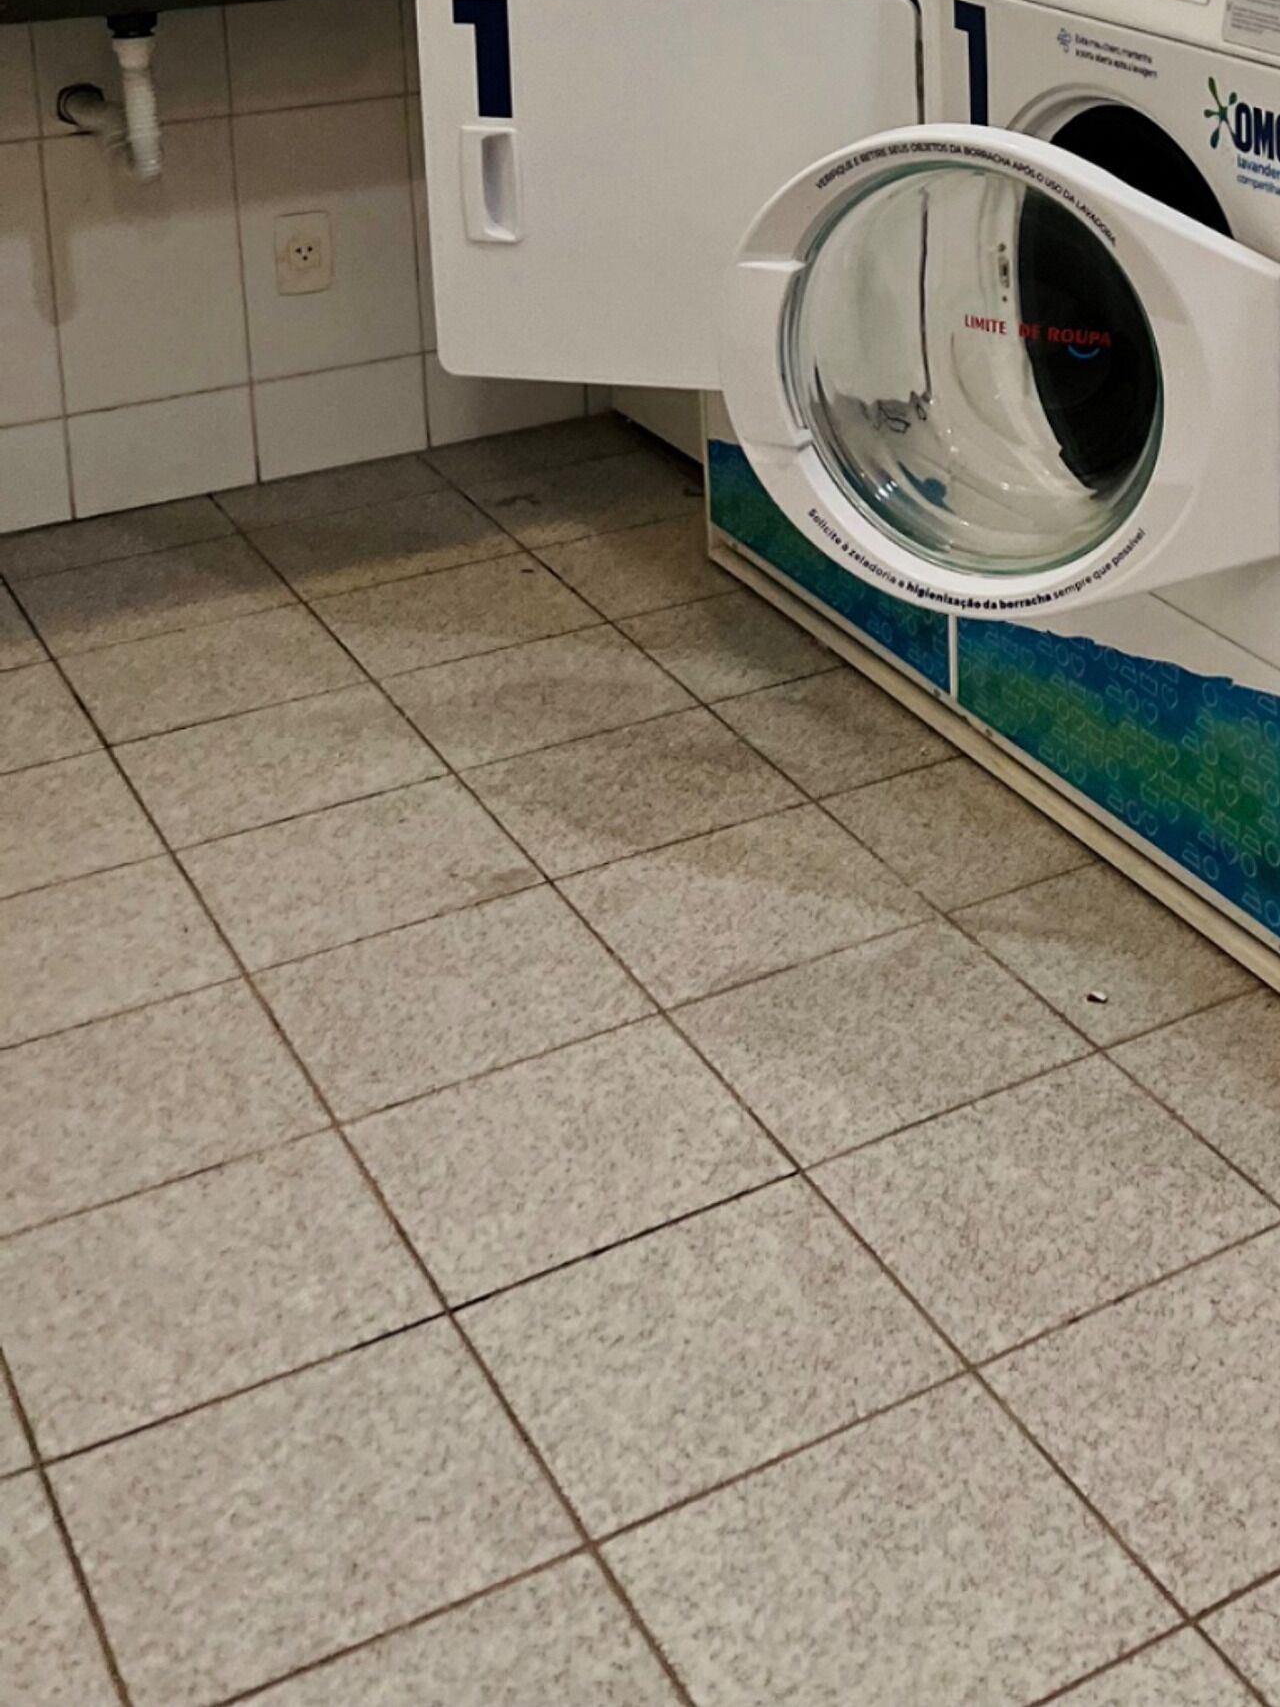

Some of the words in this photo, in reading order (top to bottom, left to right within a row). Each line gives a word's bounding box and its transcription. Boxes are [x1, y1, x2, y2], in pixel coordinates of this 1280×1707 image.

[888, 143, 910, 155] SEUS
[949, 144, 962, 154] DA
[964, 146, 1011, 167] BORRACHA
[1012, 161, 1036, 179] APÓS
[1036, 172, 1045, 183] O
[1044, 178, 1063, 195] USO
[1063, 189, 1076, 203] DA
[965, 314, 1007, 335] LIMITE
[1018, 322, 1040, 339] DE
[1047, 327, 1112, 347] ROUPA
[808, 508, 842, 545] Solicite
[848, 548, 897, 585] zeladoria
[906, 583, 981, 611] higienização
[983, 599, 997, 610] da
[998, 592, 1052, 610] borracha
[1053, 575, 1092, 600] sempre
[1093, 562, 1112, 581] que
[1111, 527, 1147, 567] possível
